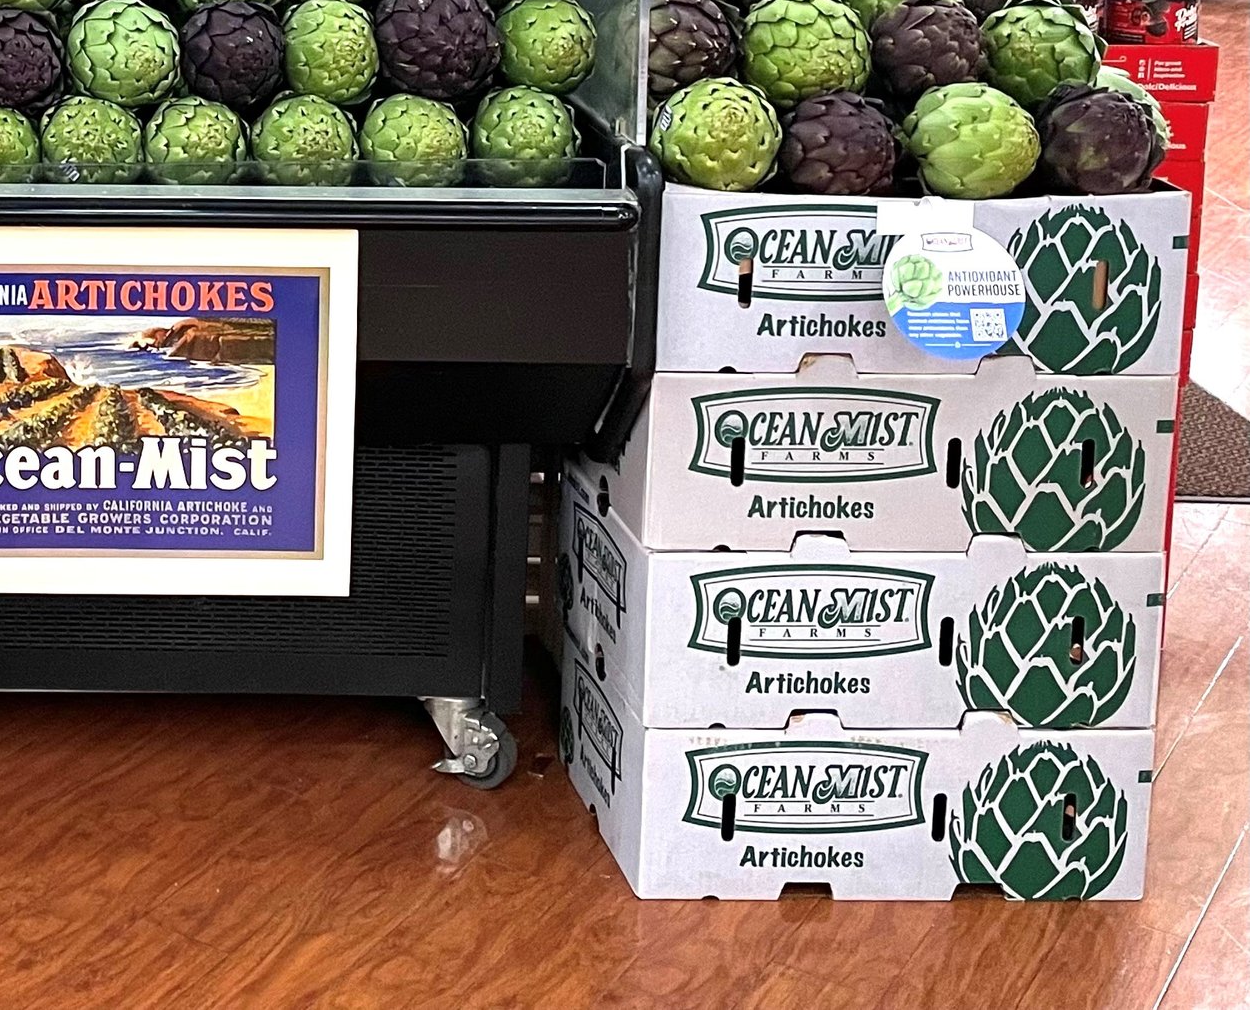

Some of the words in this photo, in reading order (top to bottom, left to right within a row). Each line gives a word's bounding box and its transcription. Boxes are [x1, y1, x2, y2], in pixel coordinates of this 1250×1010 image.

[724, 227, 837, 266] OCEAN
[948, 270, 1016, 282] ANTIOXIDANT
[28, 280, 274, 312] ARTICHOKES
[948, 284, 1021, 296] POWERHOUSE
[757, 313, 887, 337] Artichokes
[714, 410, 827, 447] OCEAN
[820, 411, 919, 452] MIST
[760, 450, 875, 462] FARMS
[21, 503, 40, 511] AND
[44, 503, 82, 511] SHIPPED
[86, 503, 99, 511] BY
[103, 500, 173, 511] CALIFORNIA
[177, 501, 248, 512] ARTICHOKE
[748, 495, 875, 520] Artichokes
[12, 526, 49, 534] OFFICE
[55, 525, 85, 534] DEL
[90, 526, 141, 534] MONTE
[145, 526, 224, 535] JUNCTION.
[233, 528, 272, 536] CALIF.
[77, 513, 151, 524] GROWERS
[159, 514, 272, 525] CORPORATION
[713, 587, 823, 625] OCEAN
[817, 587, 914, 629] MIST
[758, 627, 872, 639] FARMS
[745, 671, 871, 695] Artichokes
[708, 764, 818, 799] OCEAN
[812, 764, 908, 804] MIST
[753, 803, 865, 814] FARMS
[740, 845, 864, 870] Artichokes
